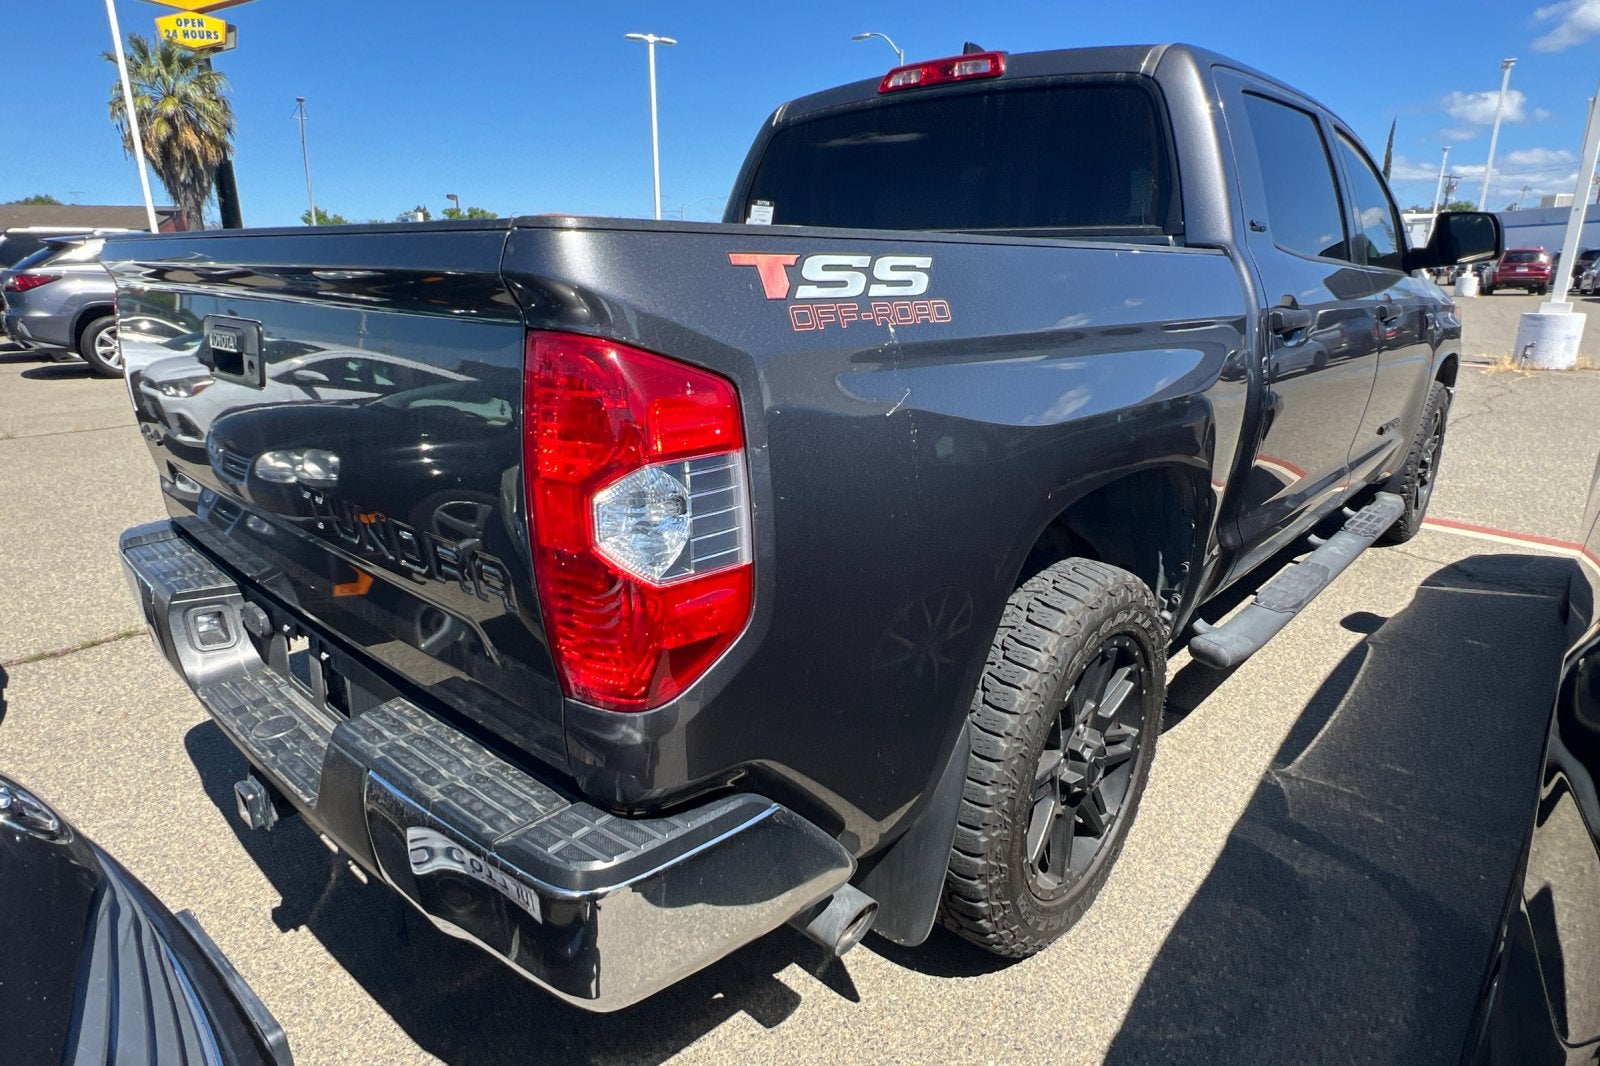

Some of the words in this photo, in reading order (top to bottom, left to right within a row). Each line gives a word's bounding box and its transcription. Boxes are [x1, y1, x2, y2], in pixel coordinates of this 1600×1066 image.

[176, 18, 204, 28] OPEN
[165, 29, 178, 39] 24
[183, 30, 219, 40] HOURS
[728, 253, 933, 300] TSS
[789, 300, 951, 332] OFF-ROAD
